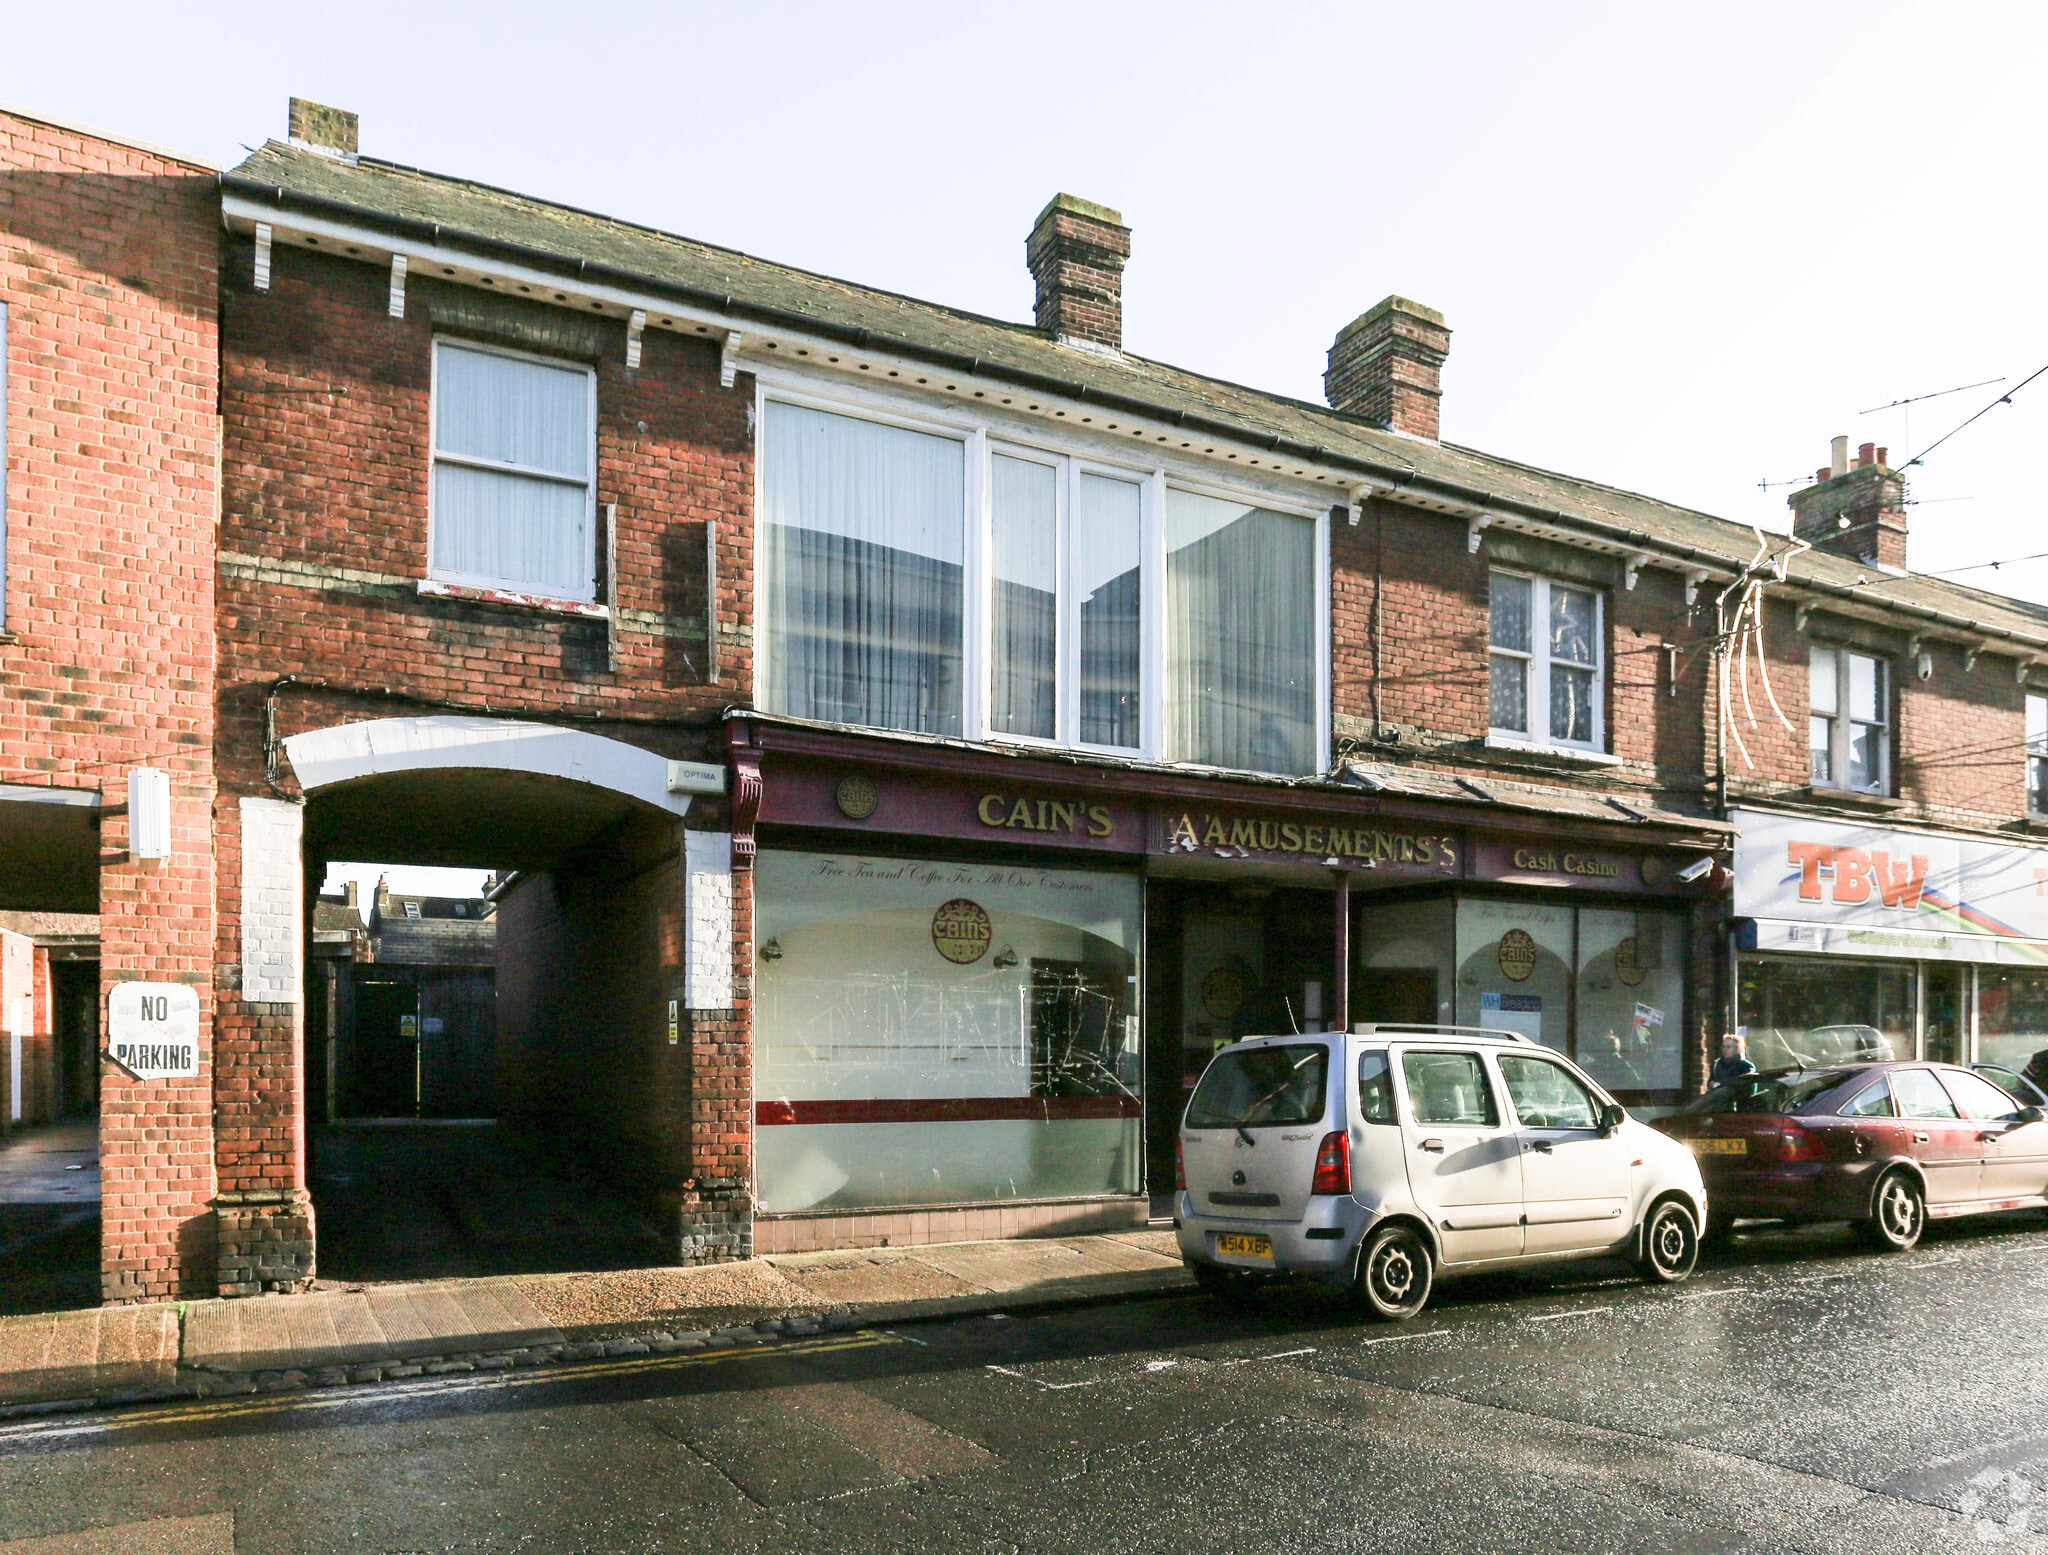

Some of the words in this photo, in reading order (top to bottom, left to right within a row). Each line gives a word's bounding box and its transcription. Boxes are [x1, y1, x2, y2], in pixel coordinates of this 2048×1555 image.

[684, 770, 716, 780] OPTIMA
[978, 794, 1113, 837] CAIN'S
[811, 860, 845, 876] Free
[848, 861, 874, 878] Tea
[877, 866, 904, 879] and
[906, 863, 943, 887] Coffee
[947, 868, 975, 884] For
[982, 870, 1003, 888] All
[1007, 871, 1033, 888] Our
[1514, 850, 1558, 871] Cash
[1563, 853, 1620, 877] Casino
[1787, 840, 1930, 912] TBW
[141, 996, 168, 1021] NO
[117, 1044, 191, 1070] PARKING
[1247, 1238, 1269, 1255] XBF
